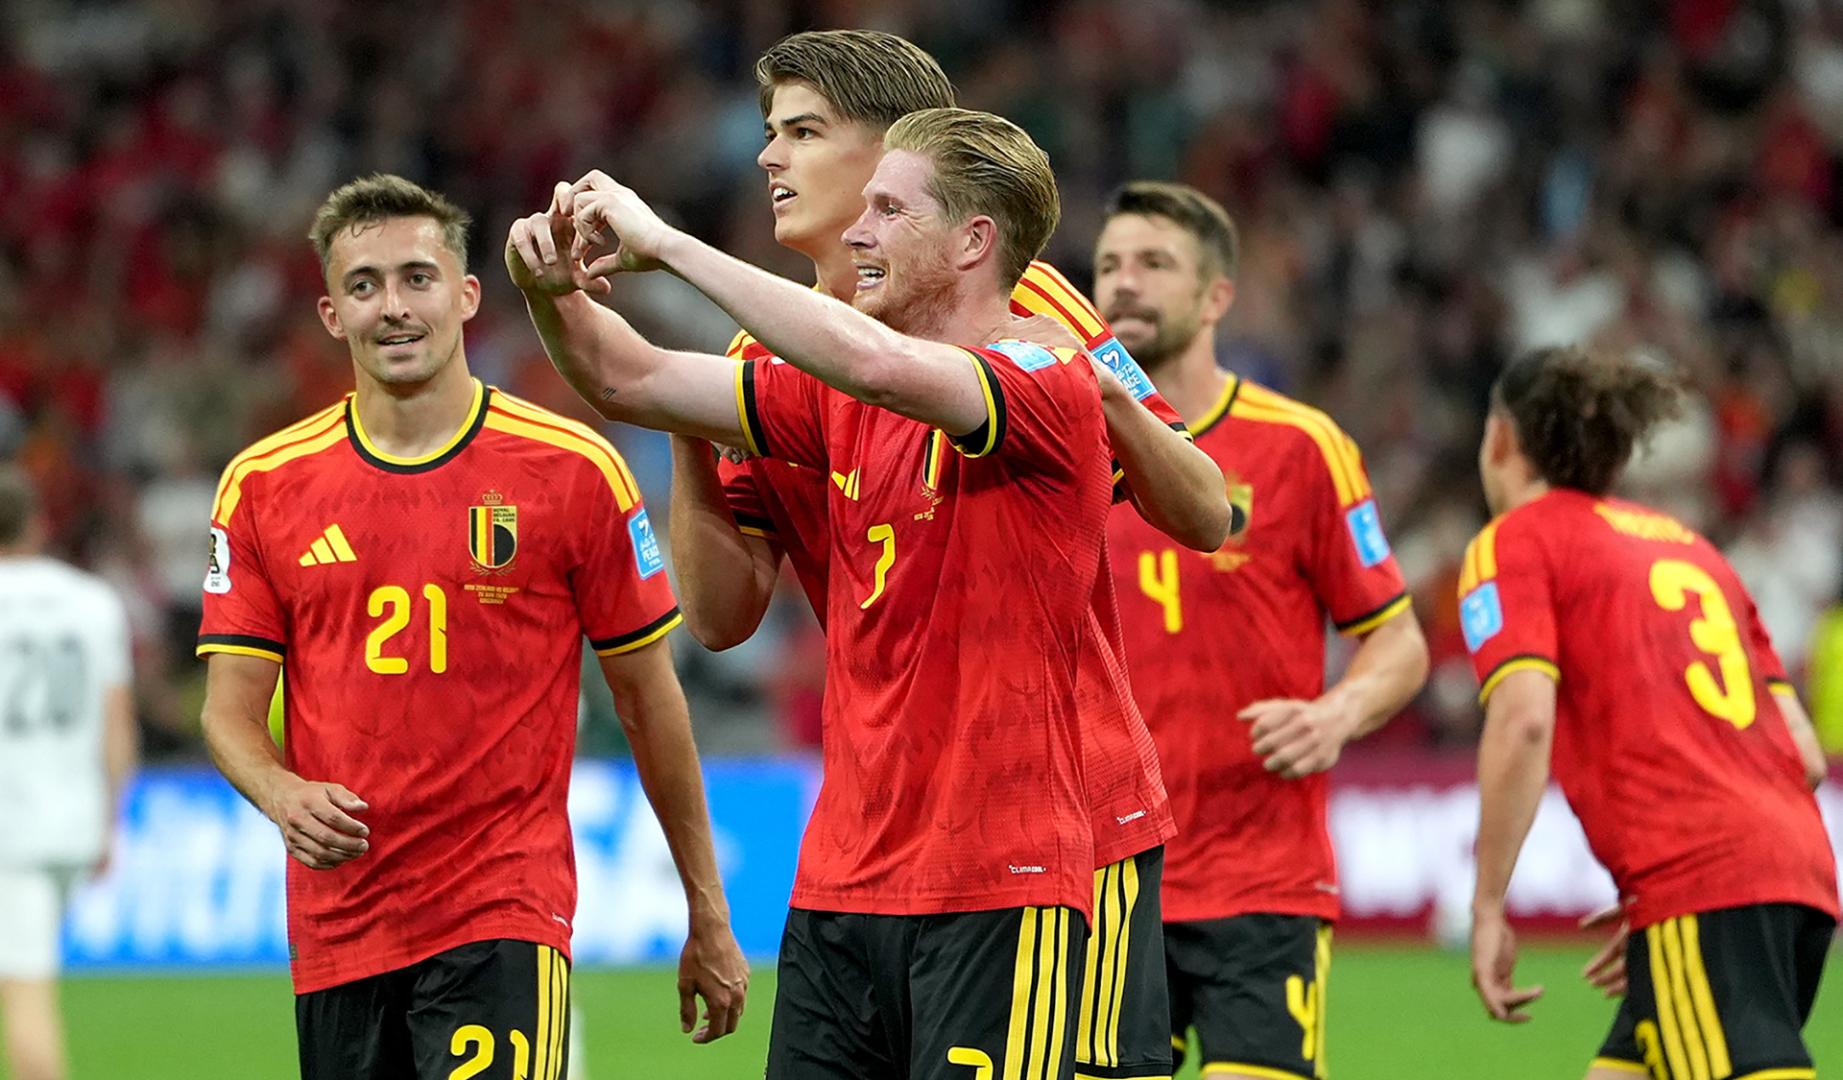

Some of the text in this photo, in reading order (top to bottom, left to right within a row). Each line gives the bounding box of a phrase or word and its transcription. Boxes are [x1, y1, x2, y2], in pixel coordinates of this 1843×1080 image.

[861, 524, 895, 609] 7
[1138, 550, 1182, 634] 4
[365, 583, 447, 674] 21
[1649, 560, 1756, 730] 3
[448, 1025, 529, 1080] 21
[1286, 975, 1316, 1061] 4
